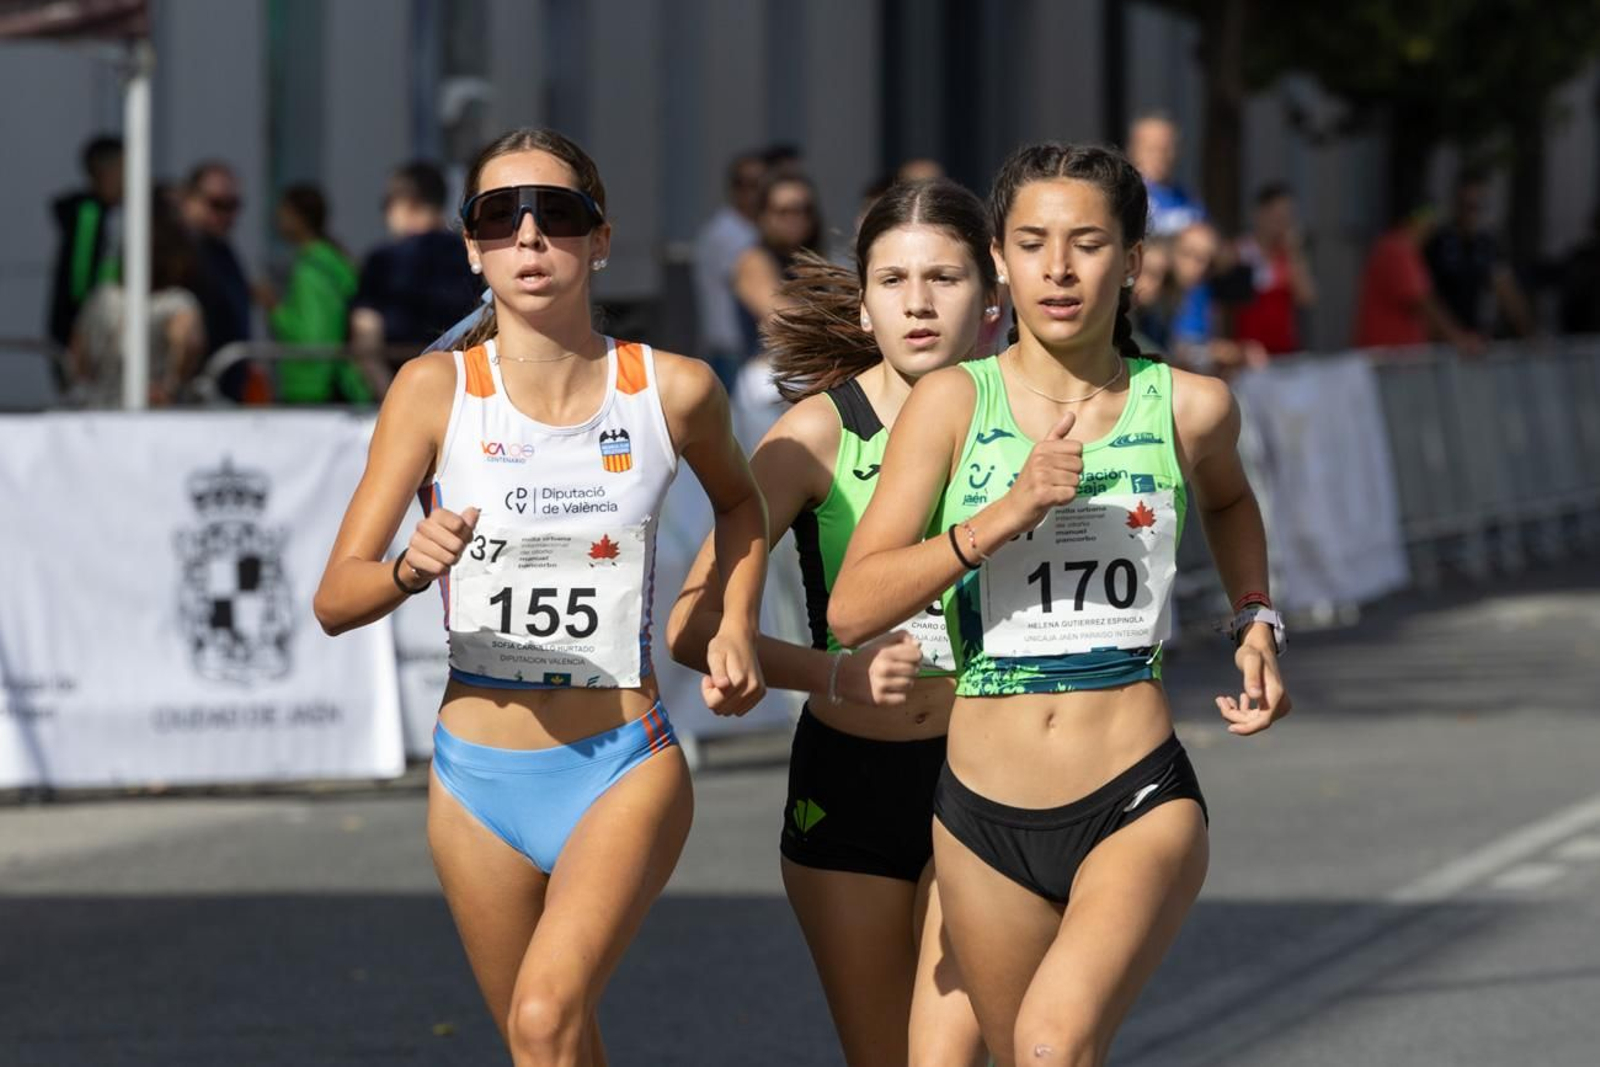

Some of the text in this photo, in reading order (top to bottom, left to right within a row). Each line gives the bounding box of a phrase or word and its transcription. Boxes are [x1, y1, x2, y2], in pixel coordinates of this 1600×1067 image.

[542, 486, 606, 501] Diputació
[542, 501, 618, 515] de València
[1076, 505, 1107, 513] urbana
[470, 534, 507, 563] 37
[1027, 558, 1138, 614] 170
[489, 586, 599, 639] 155
[911, 621, 939, 630] CHARO
[1027, 616, 1144, 630] HELENA GUTIERREZ ESPINOLA
[1023, 633, 1058, 642] UNICAJA
[1059, 632, 1079, 641] JAEN
[1115, 628, 1149, 638] INTERIOR
[491, 641, 596, 653] SOFIA CARRILLO HURTADO
[500, 654, 586, 666] DIPUTACION VALENCIA
